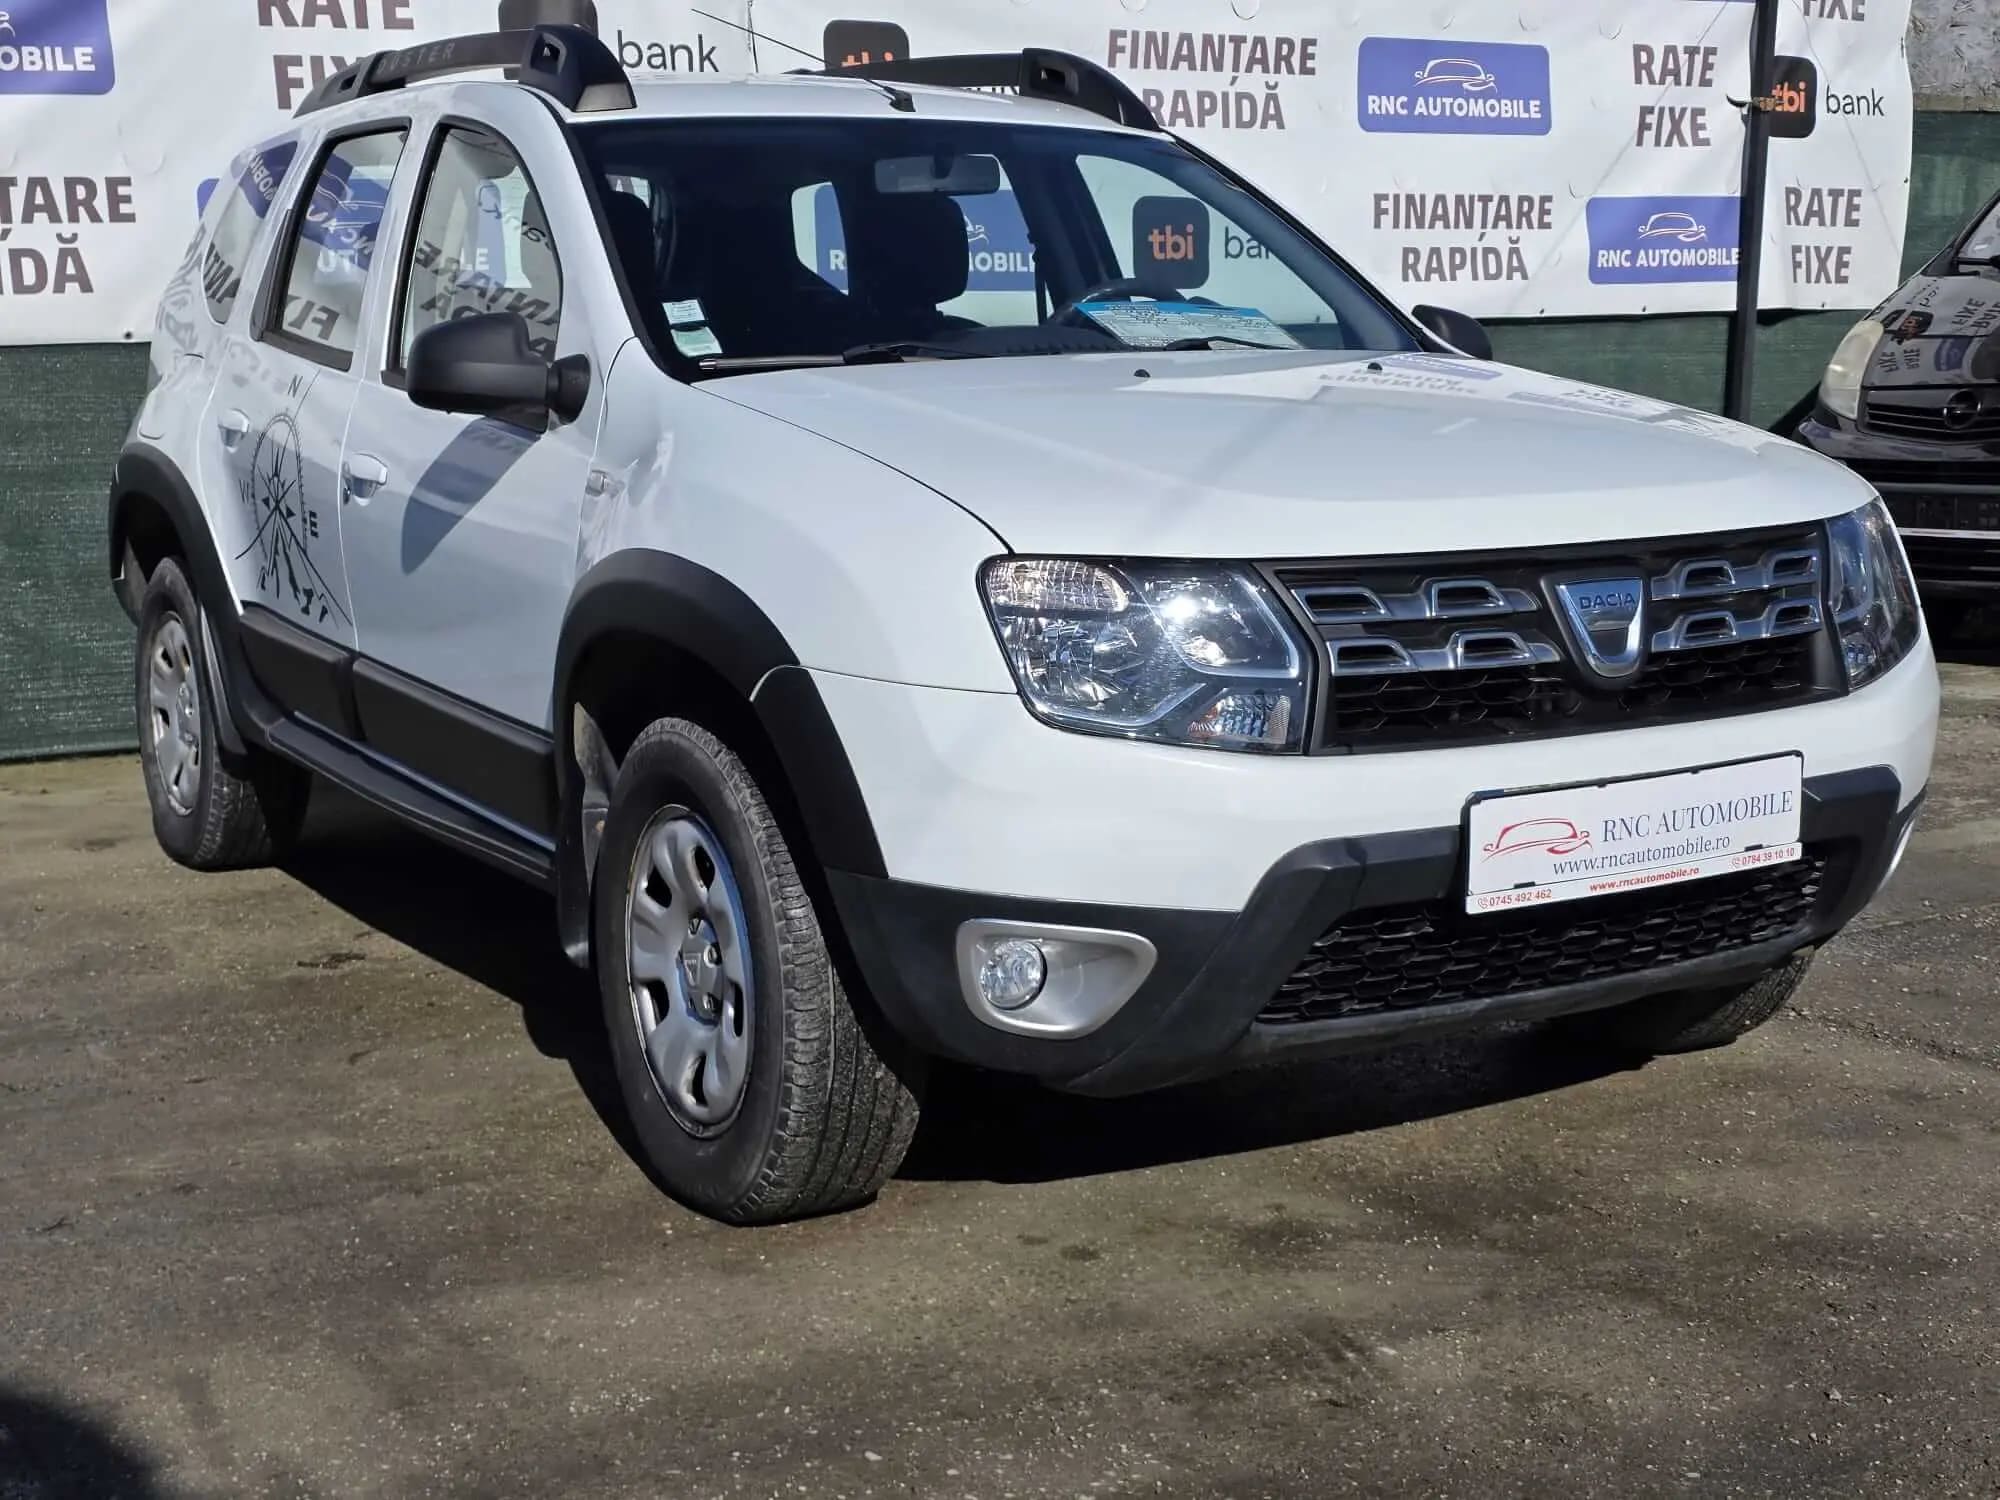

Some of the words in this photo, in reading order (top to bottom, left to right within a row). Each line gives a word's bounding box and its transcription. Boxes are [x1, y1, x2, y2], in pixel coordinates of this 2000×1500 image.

[617, 29, 719, 73] bank
[1632, 43, 1718, 88] RATE
[1367, 95, 1408, 116] RNC
[1414, 97, 1542, 119] AUTOMOBILE
[1826, 84, 1884, 117] bank
[1635, 105, 1711, 148] FIXE
[1784, 187, 1863, 228] RATE
[1148, 223, 1194, 260] tbi
[1597, 249, 1631, 268] RNC
[1637, 247, 1740, 268] AUTOMOBILE
[1791, 244, 1852, 284] FIXE
[1579, 592, 1636, 610] DACIA
[1602, 813, 1650, 843] RNC
[1656, 790, 1793, 835] AUTOMOBILE
[1553, 835, 1730, 875] www.rncautomobile.ro
[1489, 893, 1512, 907] 0745
[1514, 891, 1532, 904] 492
[1535, 888, 1552, 900] 462
[1589, 866, 1700, 893] www.rncautomobile.ro
